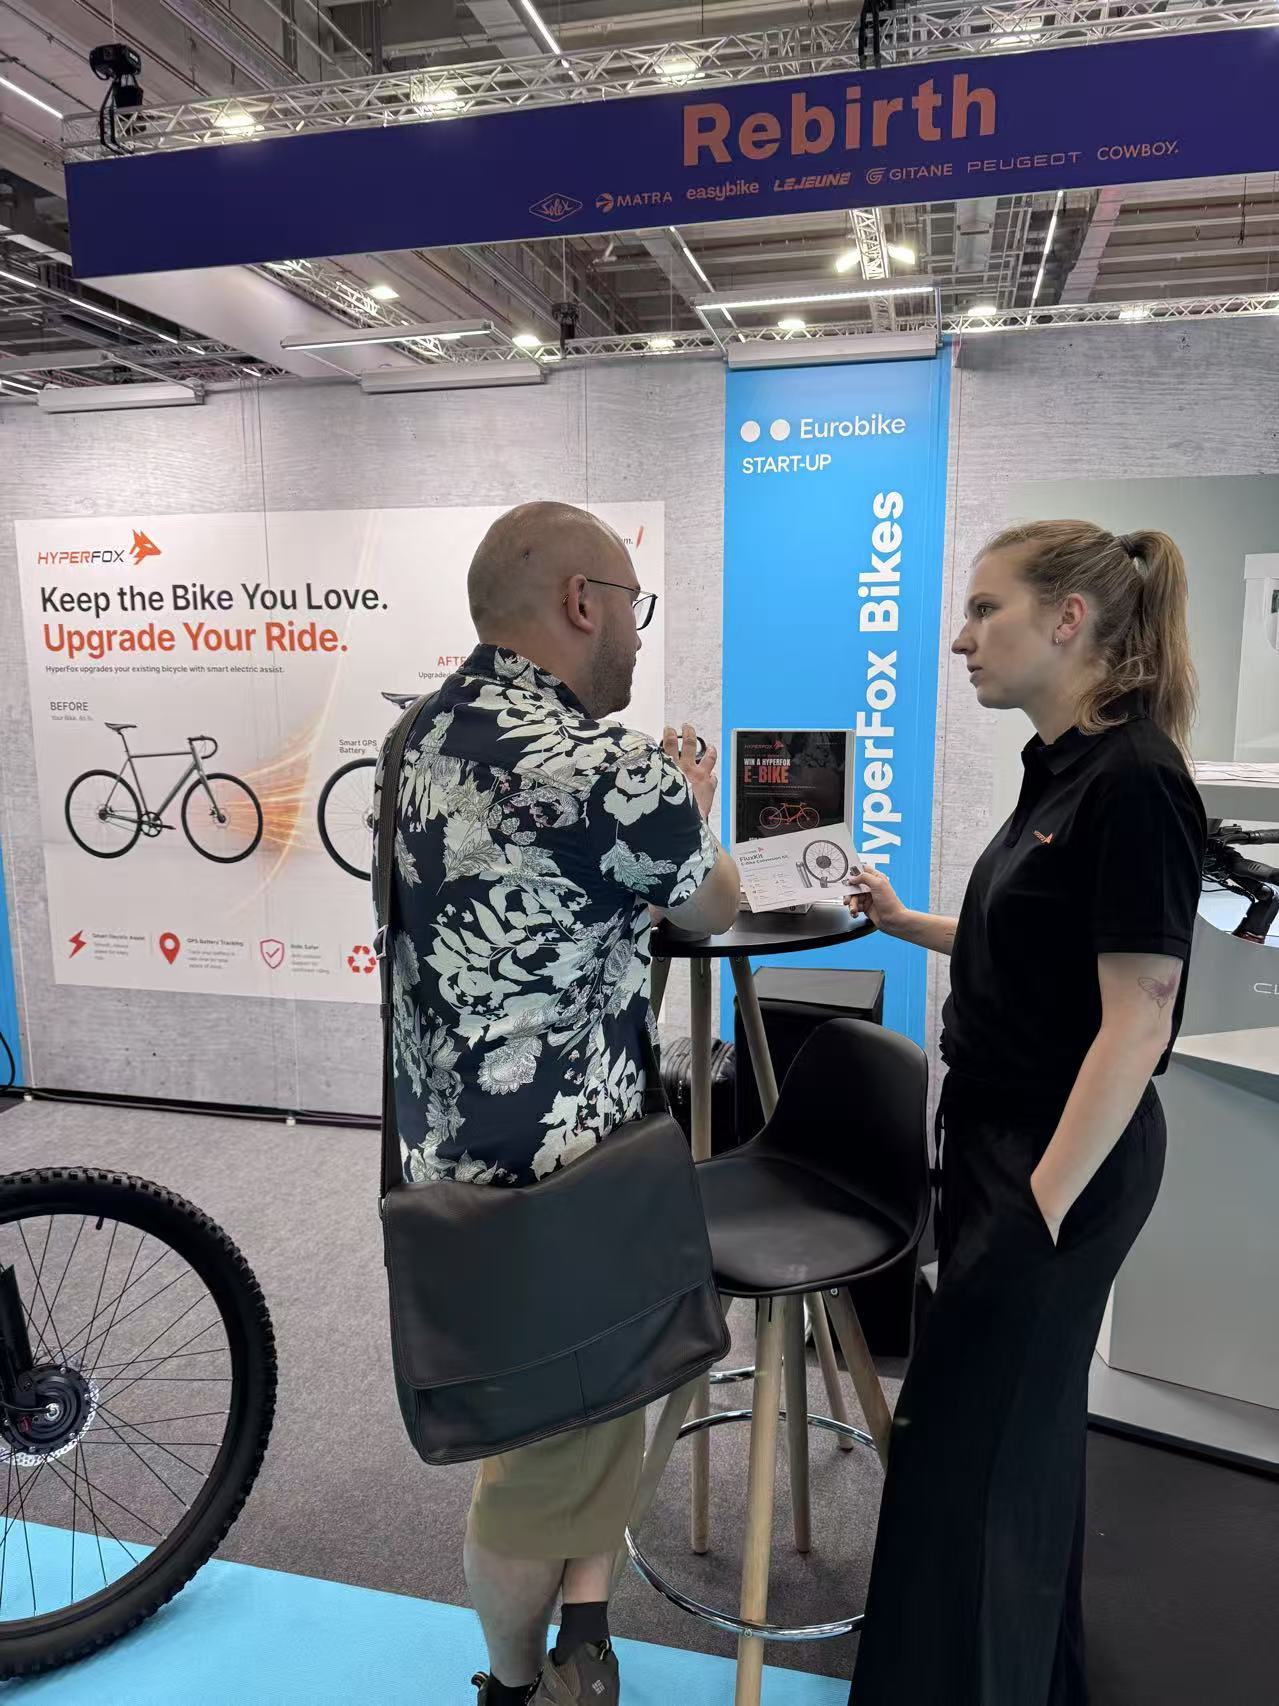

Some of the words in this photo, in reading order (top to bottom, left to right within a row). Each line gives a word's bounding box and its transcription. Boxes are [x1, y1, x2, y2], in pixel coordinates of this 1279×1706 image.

[682, 74, 996, 167] Rebirth
[616, 191, 673, 208] MATRA
[686, 180, 760, 202] easybike
[773, 171, 853, 193] LEJEUNE
[889, 163, 953, 182] GITANE
[967, 151, 1083, 174] PEUGEOT
[1097, 140, 1180, 161] COWBOY.
[800, 413, 907, 440] Eurobike
[741, 453, 832, 475] START-UP
[37, 549, 126, 566] HYPERFOX
[858, 491, 904, 633] Bikes
[40, 586, 111, 619] Keep
[117, 584, 165, 612] the
[171, 582, 234, 612] Bike
[241, 582, 298, 611] You
[305, 582, 389, 611] Love.
[43, 621, 176, 660] Upgrade
[182, 621, 257, 653] Your
[264, 620, 349, 653] Ride.
[45, 665, 79, 676] HyperFox
[80, 665, 113, 676] upgrades
[114, 667, 131, 676] your
[131, 665, 161, 676] existing
[161, 665, 189, 675] bicycle
[189, 665, 206, 674] with
[206, 666, 229, 674] smart
[230, 665, 259, 674] electric
[49, 701, 89, 712] BEFORE
[338, 739, 361, 747] Smart
[361, 739, 378, 748] GPS
[338, 747, 366, 756] Battery
[743, 758, 756, 766] WIN
[756, 758, 761, 766] A
[761, 758, 791, 767] HYPERFOX
[743, 765, 790, 784] E-BIKE
